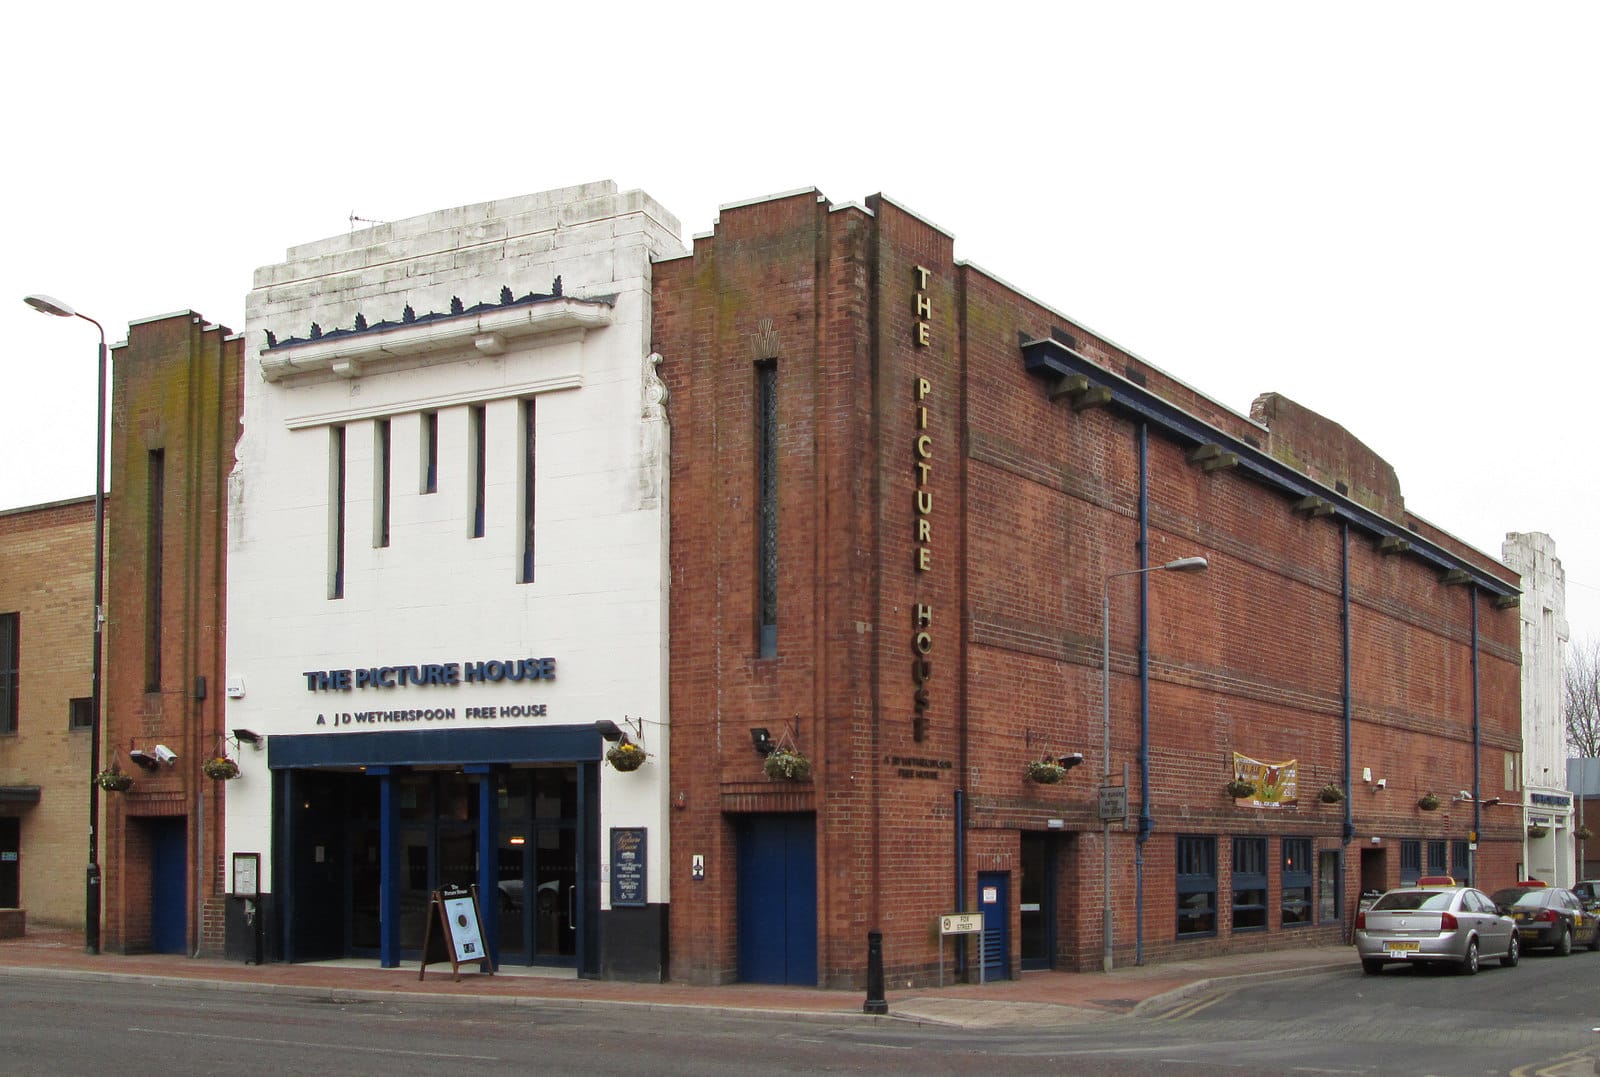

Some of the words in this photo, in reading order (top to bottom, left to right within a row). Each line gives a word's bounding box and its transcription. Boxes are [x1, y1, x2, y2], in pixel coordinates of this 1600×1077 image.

[916, 264, 932, 347] THE
[917, 377, 933, 571] PICTURE
[303, 669, 351, 692] THE
[355, 662, 460, 689] PICTURE
[464, 657, 556, 683] HOUSE
[913, 603, 932, 743] HOUSE
[316, 713, 326, 725] A
[334, 712, 339, 726] J
[342, 712, 351, 725] D
[354, 708, 456, 724] WETHERSPOON
[466, 706, 497, 720] FREE
[500, 704, 547, 718] HOUSE
